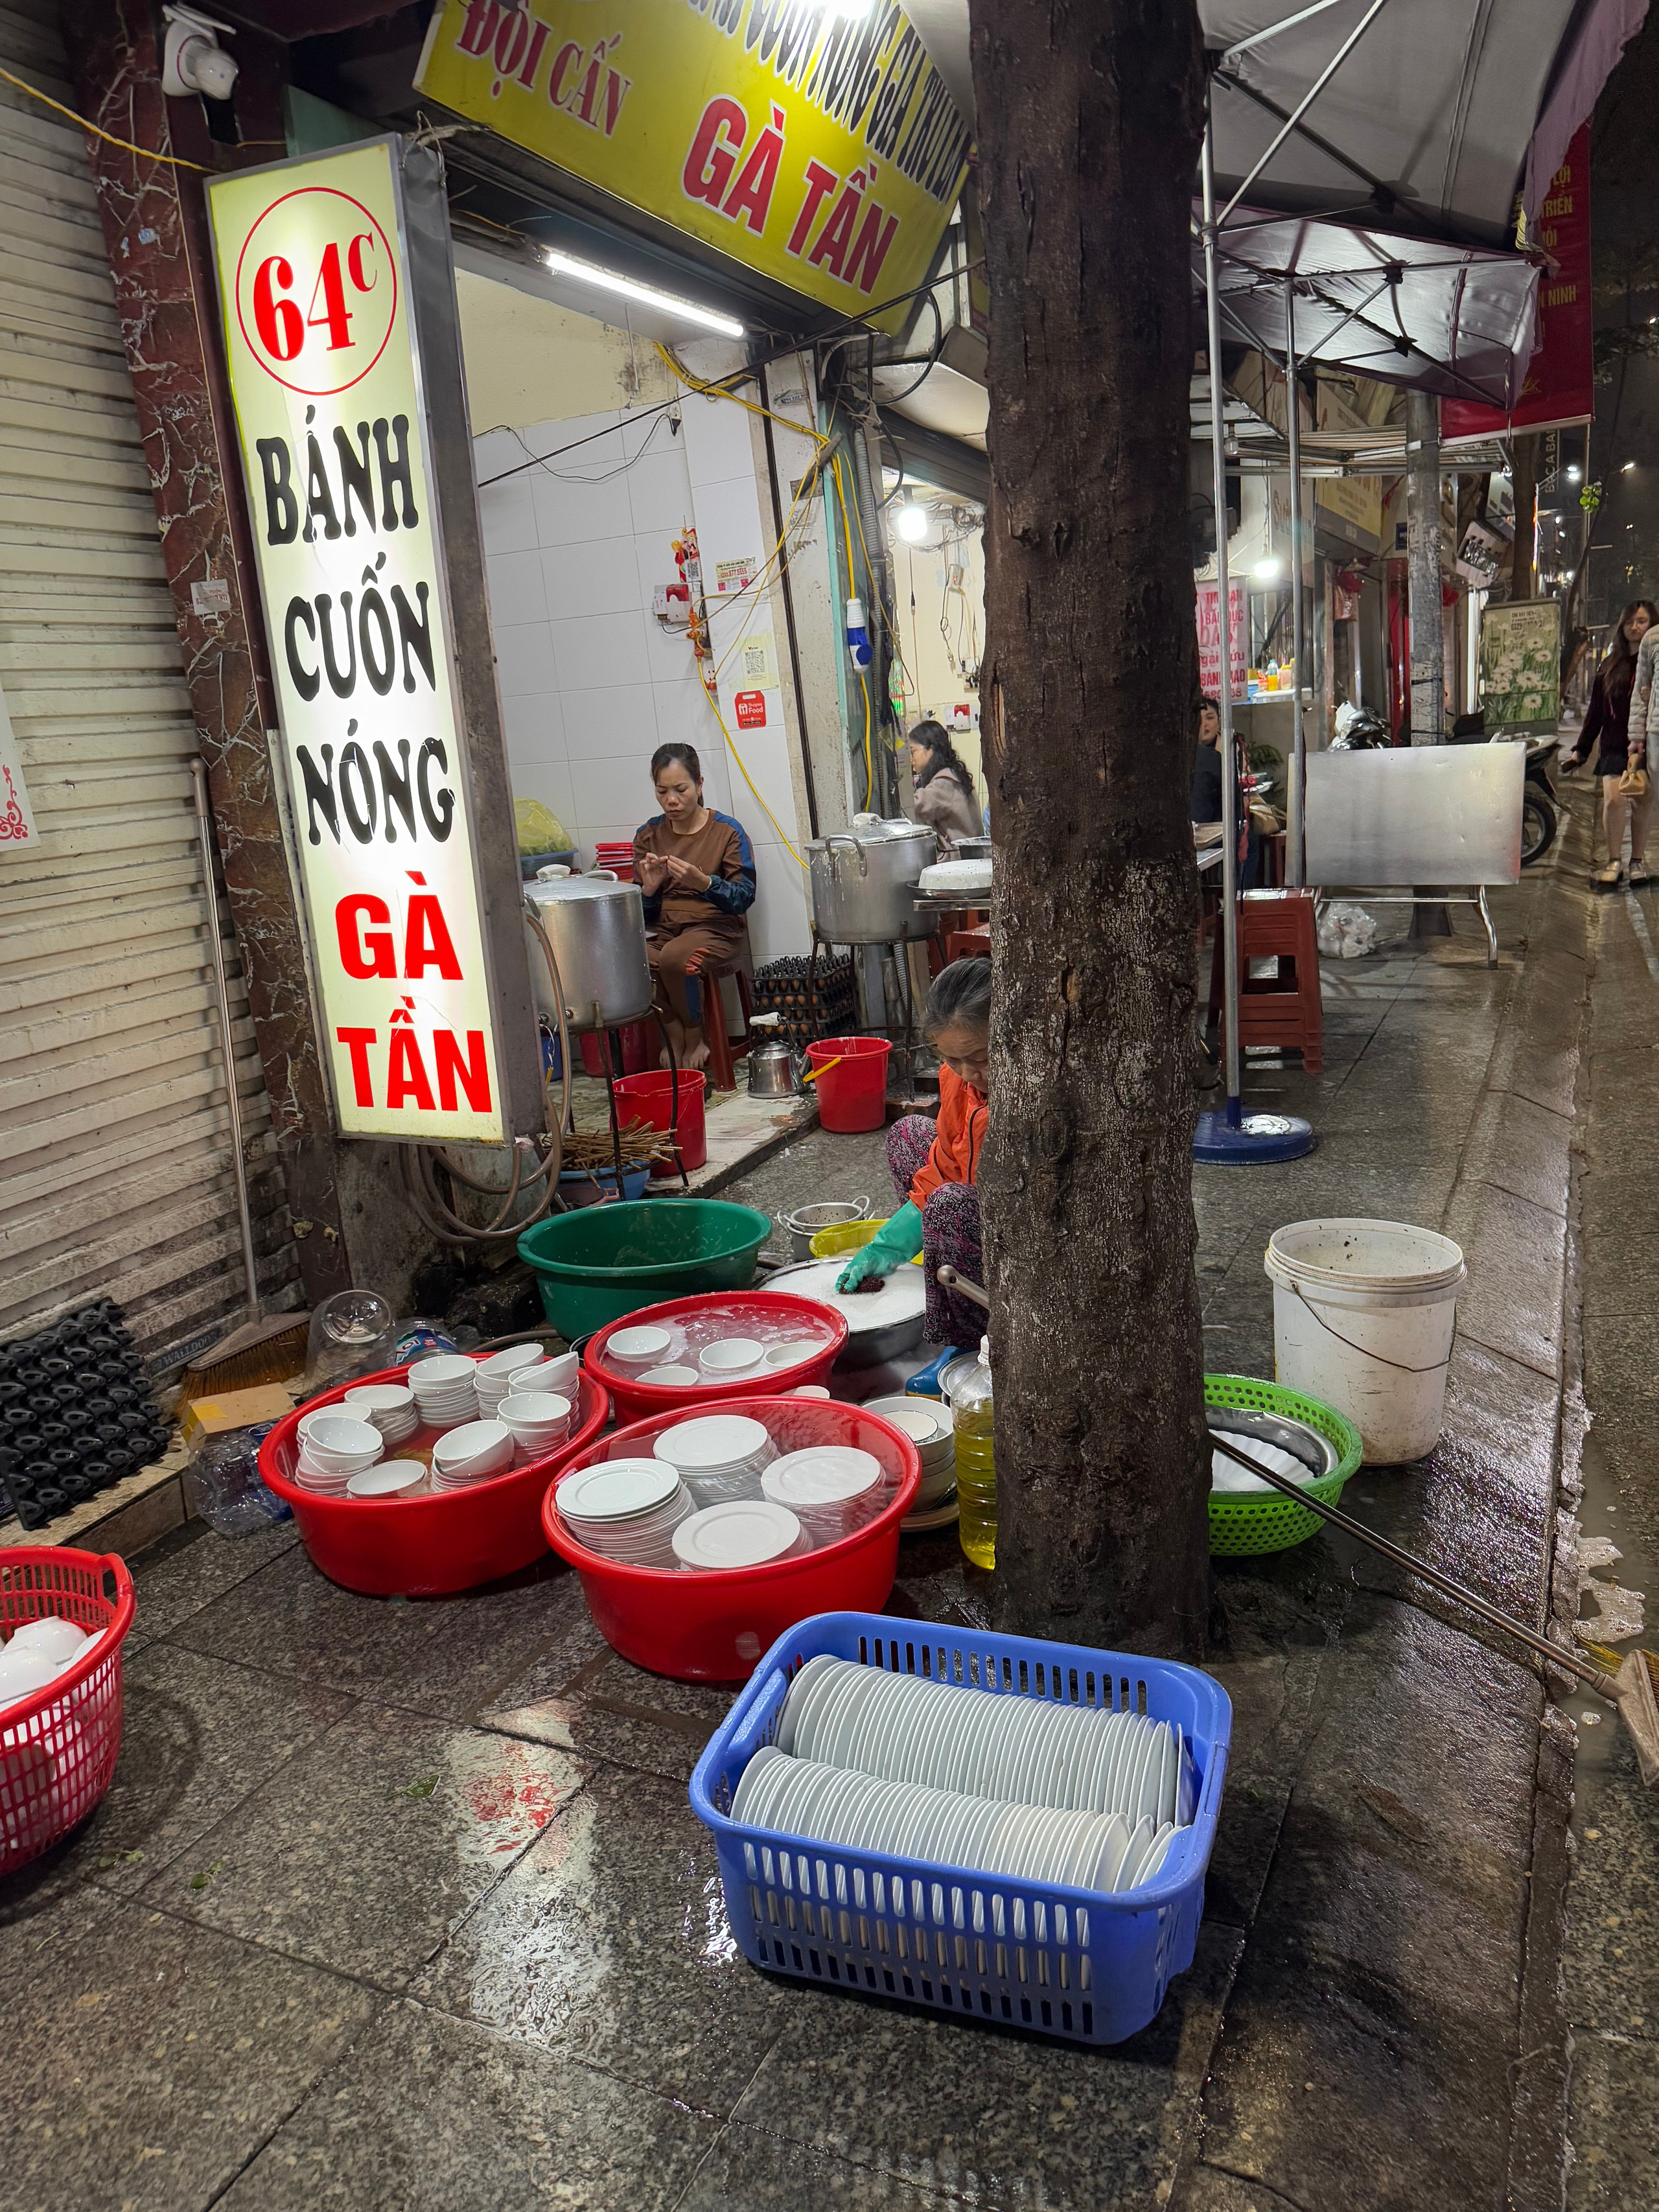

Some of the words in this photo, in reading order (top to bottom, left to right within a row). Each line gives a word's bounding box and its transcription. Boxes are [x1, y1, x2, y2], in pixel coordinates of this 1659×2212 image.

[457, 0, 551, 97] ĐỘI
[549, 33, 631, 136] CẤN
[865, 23, 927, 161] GIA
[684, 97, 786, 234] GÀ
[788, 160, 899, 294] TẦN
[1548, 285, 1577, 307] NINH
[256, 404, 419, 546] BÁNH
[285, 552, 435, 702] CUỐN
[296, 718, 454, 846] NÓNG
[335, 871, 463, 980] GÀ
[336, 995, 492, 1113] TẦN
